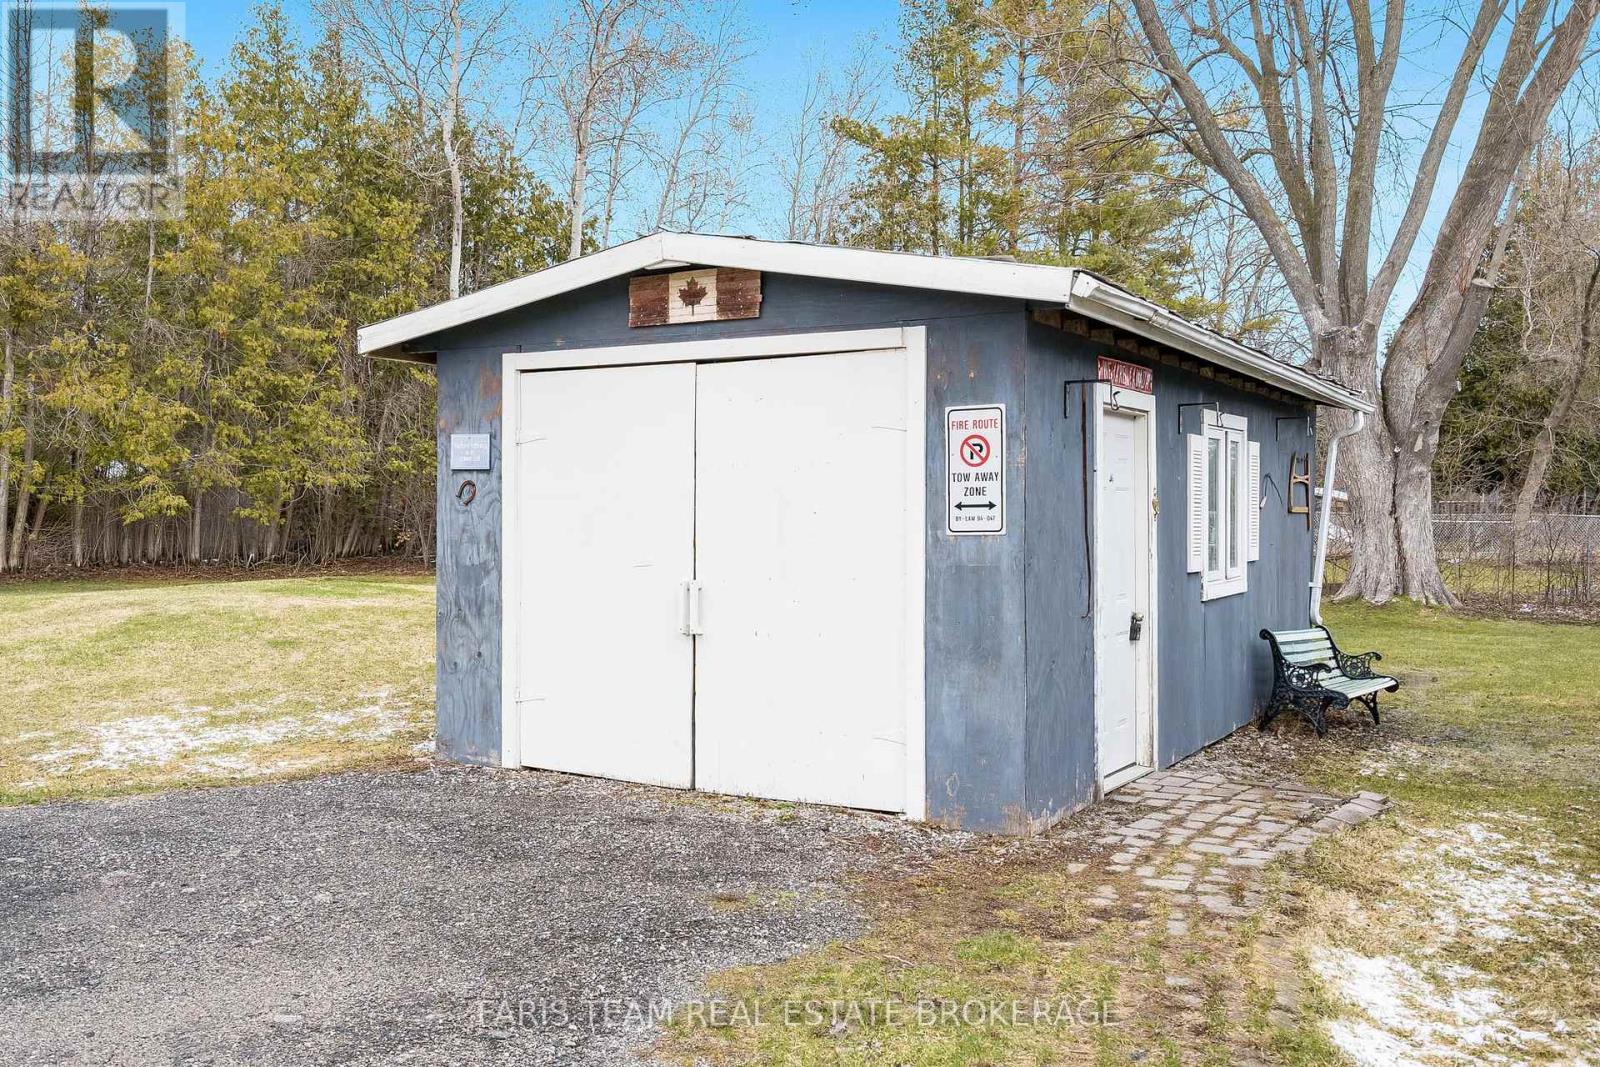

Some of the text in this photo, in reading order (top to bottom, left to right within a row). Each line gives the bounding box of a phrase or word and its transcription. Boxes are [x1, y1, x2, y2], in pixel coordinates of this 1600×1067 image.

[951, 418, 999, 431] FIRE ROUTE
[952, 471, 999, 483] TOW AWAY
[963, 486, 987, 497] ZONE
